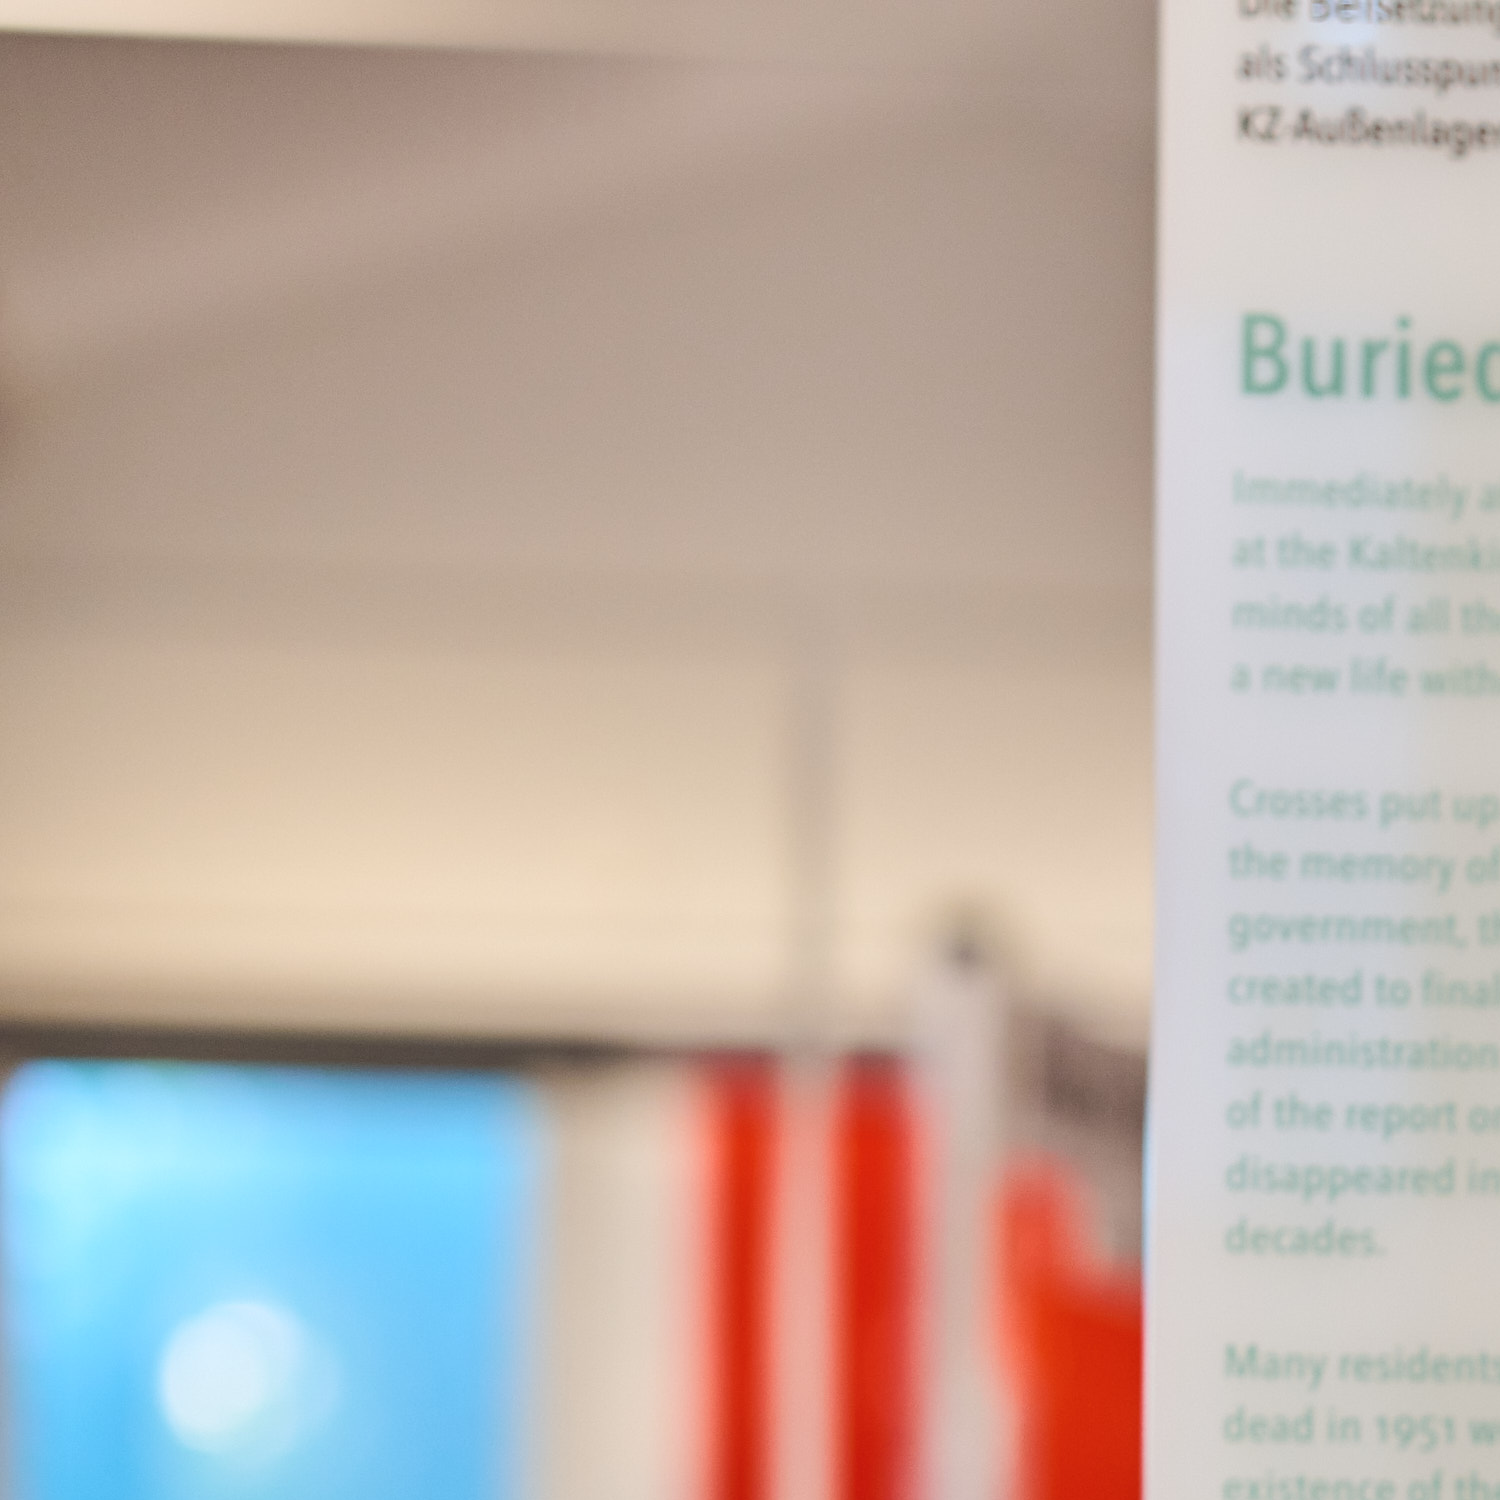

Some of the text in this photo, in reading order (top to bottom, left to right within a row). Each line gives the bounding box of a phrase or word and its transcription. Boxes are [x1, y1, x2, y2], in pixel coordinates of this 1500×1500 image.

[1236, 47, 1288, 81] als
[1231, 472, 1471, 519] Immediately
[1231, 535, 1269, 570] at
[1273, 532, 1338, 570] the
[1231, 595, 1349, 633] minds
[1357, 595, 1396, 635] of
[1405, 598, 1452, 635] all
[1260, 664, 1342, 695] new
[1348, 656, 1409, 697] life
[1227, 780, 1368, 820] Crosses
[1378, 789, 1443, 830] put
[1226, 843, 1290, 880] the
[1297, 853, 1456, 892] memory
[1226, 969, 1365, 1007] created
[1372, 975, 1413, 1007] to
[1224, 1031, 1500, 1071] administration
[1224, 1089, 1265, 1130] of
[1271, 1094, 1333, 1131] the
[1344, 1100, 1459, 1141] report
[1224, 1156, 1459, 1202] disappeared
[1222, 1344, 1327, 1388] Many
[1222, 1406, 1316, 1444] dead
[1325, 1414, 1363, 1442] in
[1375, 1415, 1457, 1452] 1951
